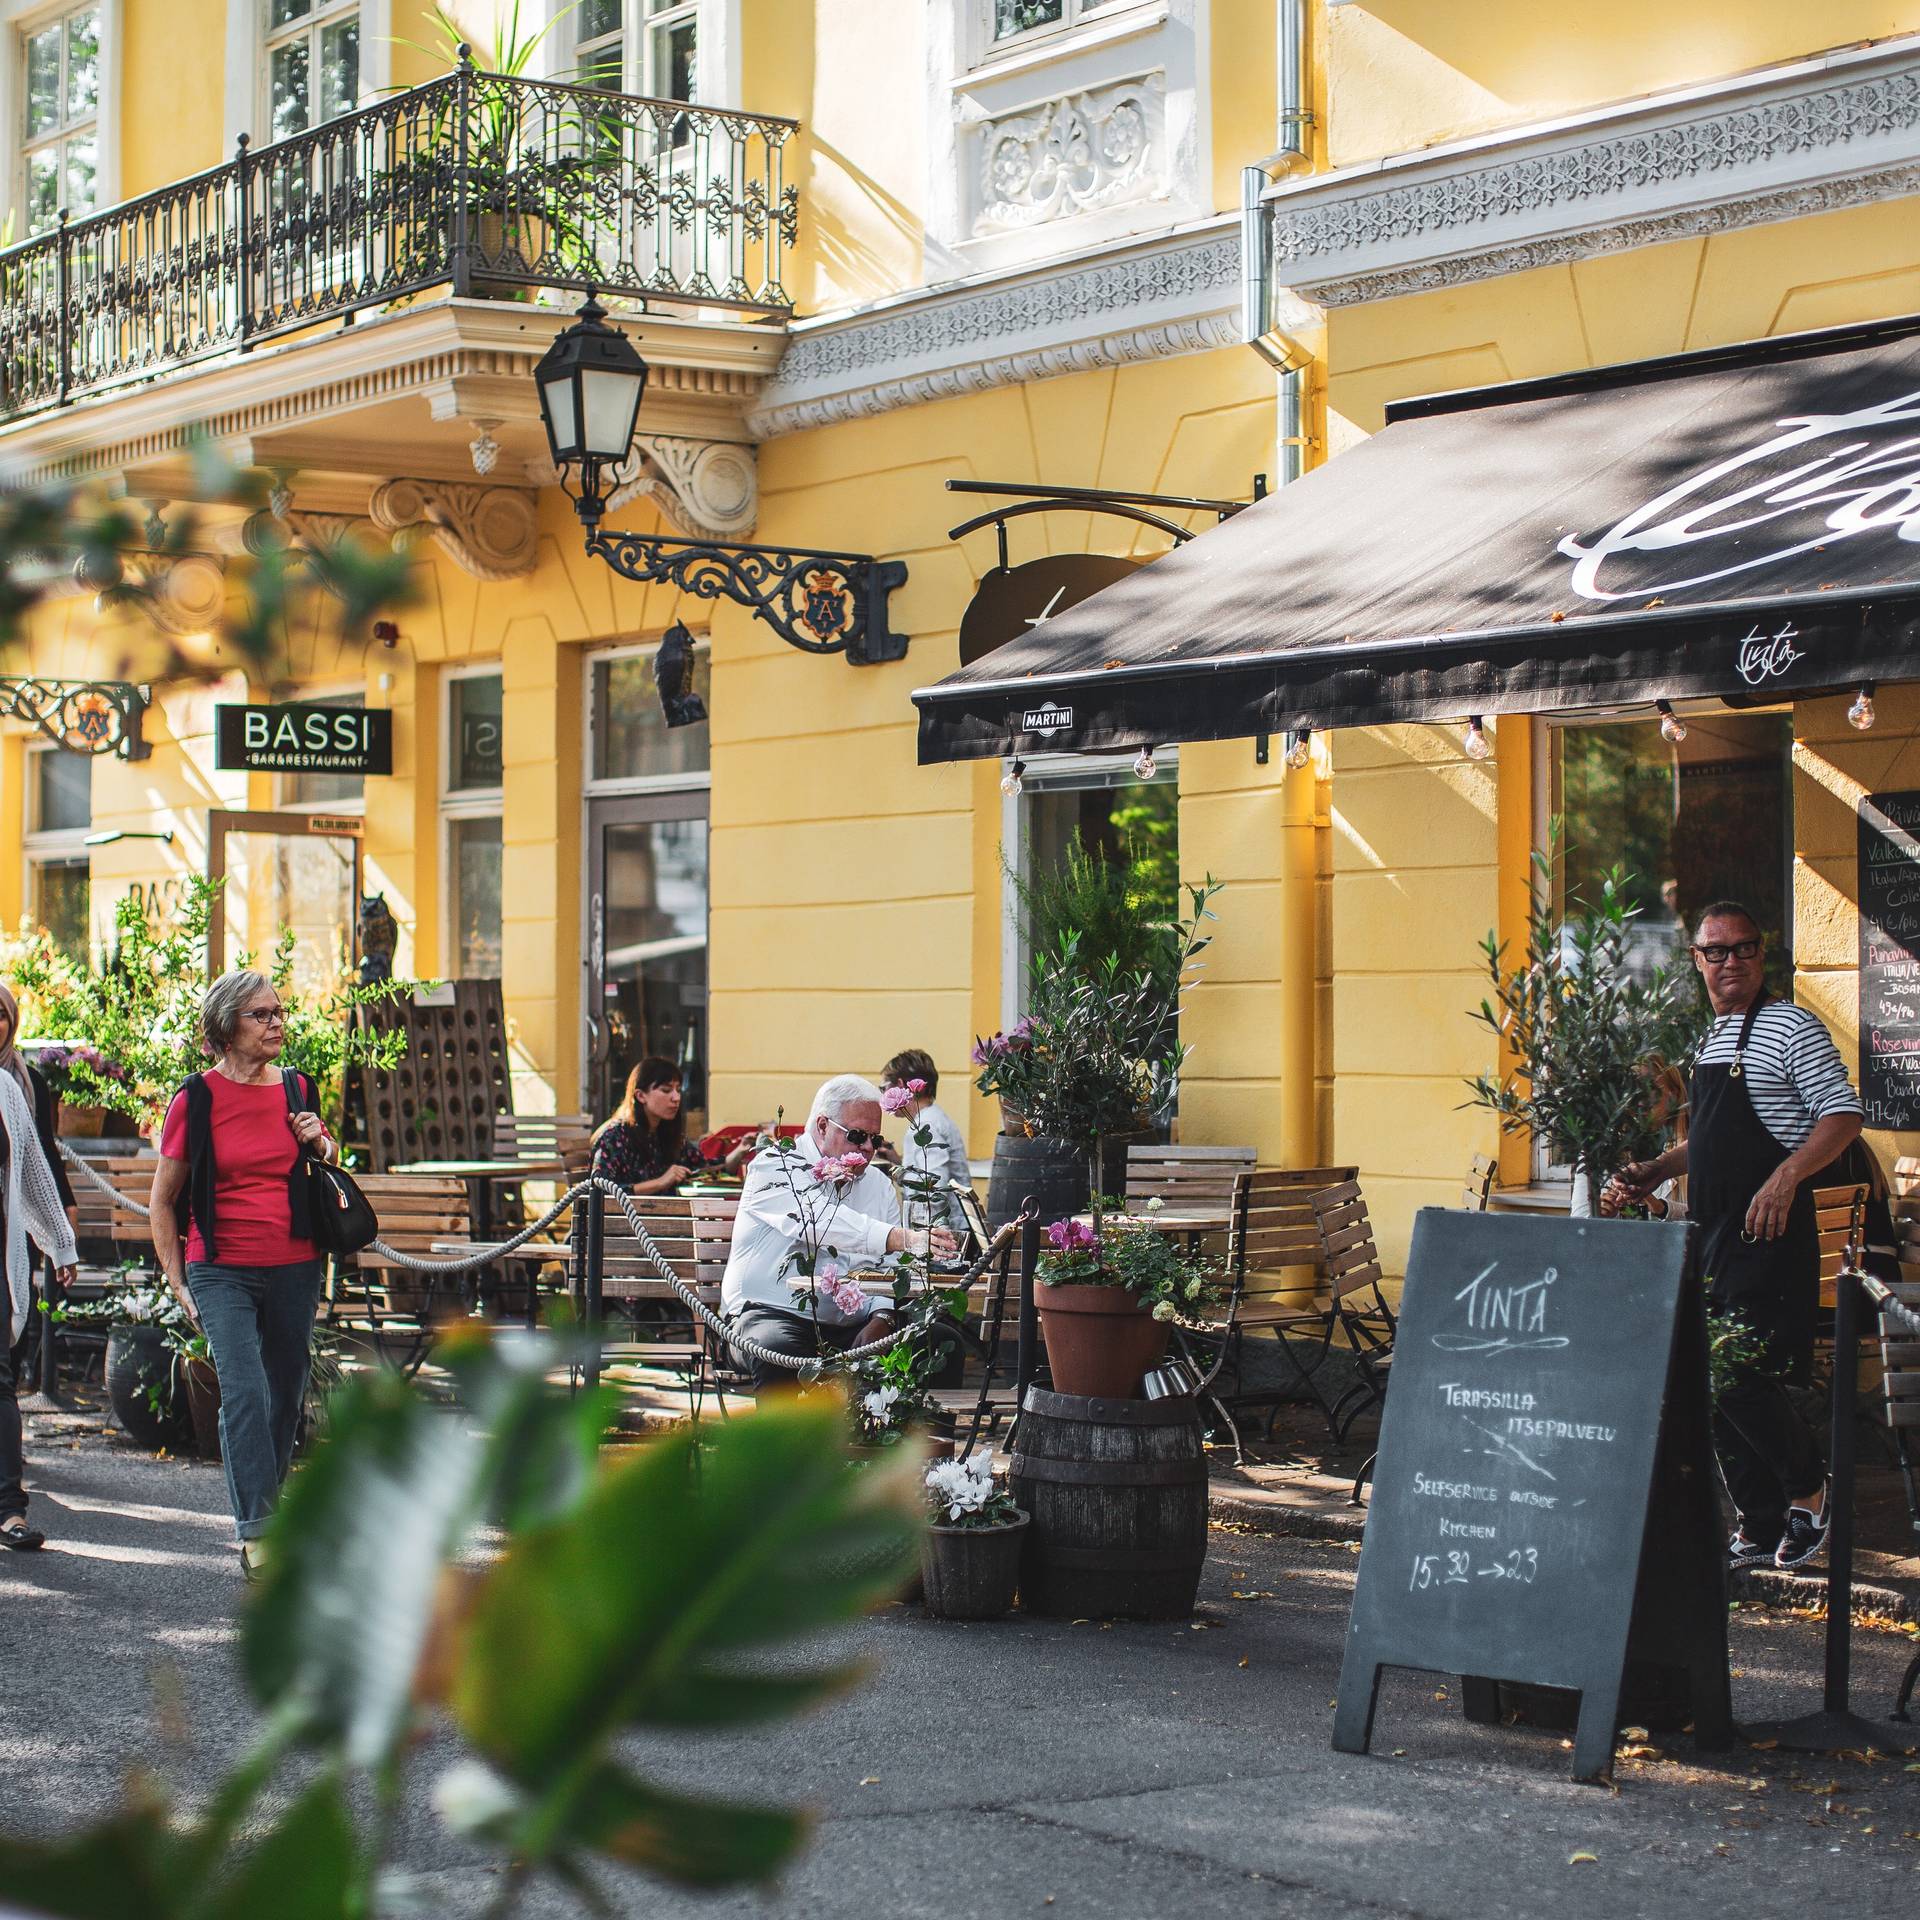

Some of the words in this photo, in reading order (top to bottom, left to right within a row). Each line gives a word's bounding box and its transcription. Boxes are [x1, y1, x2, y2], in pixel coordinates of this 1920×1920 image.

[245, 711, 368, 752] BASSI
[1025, 710, 1070, 727] MARTINI
[1438, 1383, 1537, 1411] TERASSILLA
[1508, 1417, 1617, 1442] ITSEPALVELU
[1440, 1517, 1496, 1539] KITCHEN
[1507, 1548, 1538, 1584] 23
